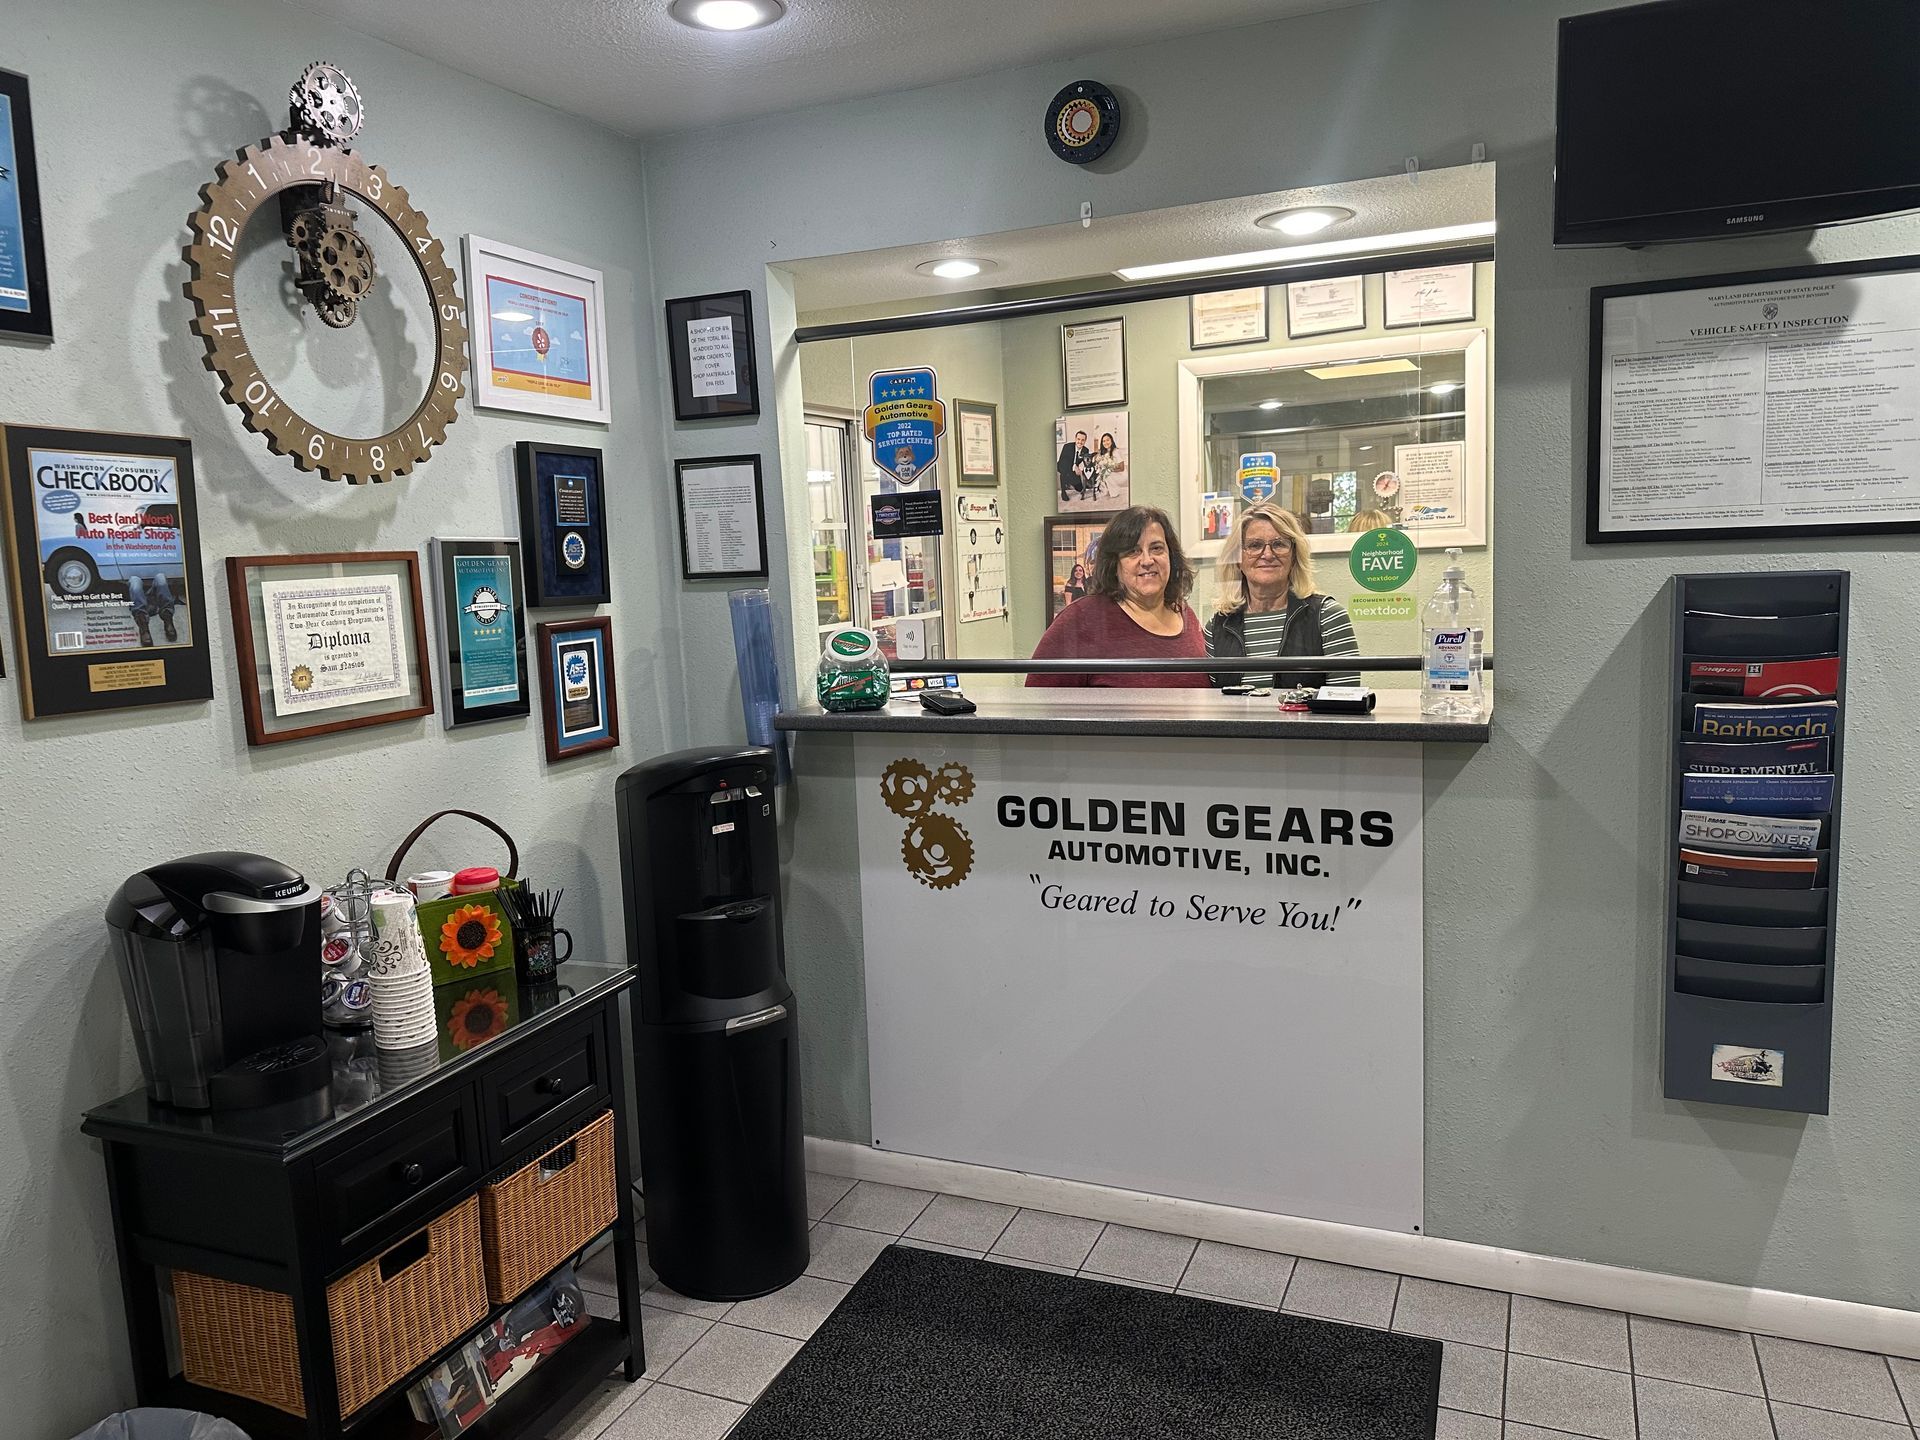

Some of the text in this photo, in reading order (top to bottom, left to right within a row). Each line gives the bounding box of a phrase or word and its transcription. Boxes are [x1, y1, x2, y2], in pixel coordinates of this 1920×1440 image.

[308, 149, 325, 175] 2
[248, 163, 267, 190] 1
[367, 175, 382, 200] 3
[1727, 214, 1764, 224] SAMSUNG
[207, 215, 238, 252] 12
[416, 236, 432, 254] 4
[442, 304, 459, 320] 5
[209, 308, 237, 336] 11
[1690, 325, 1736, 336] VEHICLE
[1740, 321, 1780, 332] SAFETY
[1783, 315, 1849, 328] INSPECTION
[441, 372, 458, 392] 6
[245, 381, 275, 417] 10
[874, 402, 933, 414] Golden Gears
[880, 411, 928, 421] Automotive
[417, 423, 434, 448] 7
[878, 438, 905, 448] SERVICE
[309, 434, 324, 459] 9
[370, 446, 384, 471] 8
[37, 465, 172, 494] CHECKBOOK
[88, 512, 173, 526] Best (and Worst)
[77, 528, 175, 541] Auto Repair Shops
[125, 543, 161, 552] Washington
[568, 544, 580, 552] ASE
[1362, 549, 1404, 557] Neighborhood
[1362, 556, 1404, 571] FAVE
[298, 600, 331, 609] Recognition
[1353, 606, 1410, 615] nextdoor
[297, 611, 328, 619] Automotive
[305, 621, 319, 629] Year
[307, 631, 371, 650] Diploma
[331, 652, 352, 661] granted
[320, 661, 364, 672] Sam Nasios
[570, 663, 583, 675] ASE
[996, 795, 1394, 848] GOLDEN GEARS
[1686, 824, 1813, 846] SHOPOWNER
[1048, 840, 1330, 878] AUTOMOTIVE, INC.
[275, 884, 302, 897] KEURIG
[1150, 895, 1176, 918] to
[1185, 894, 1266, 926] Serve
